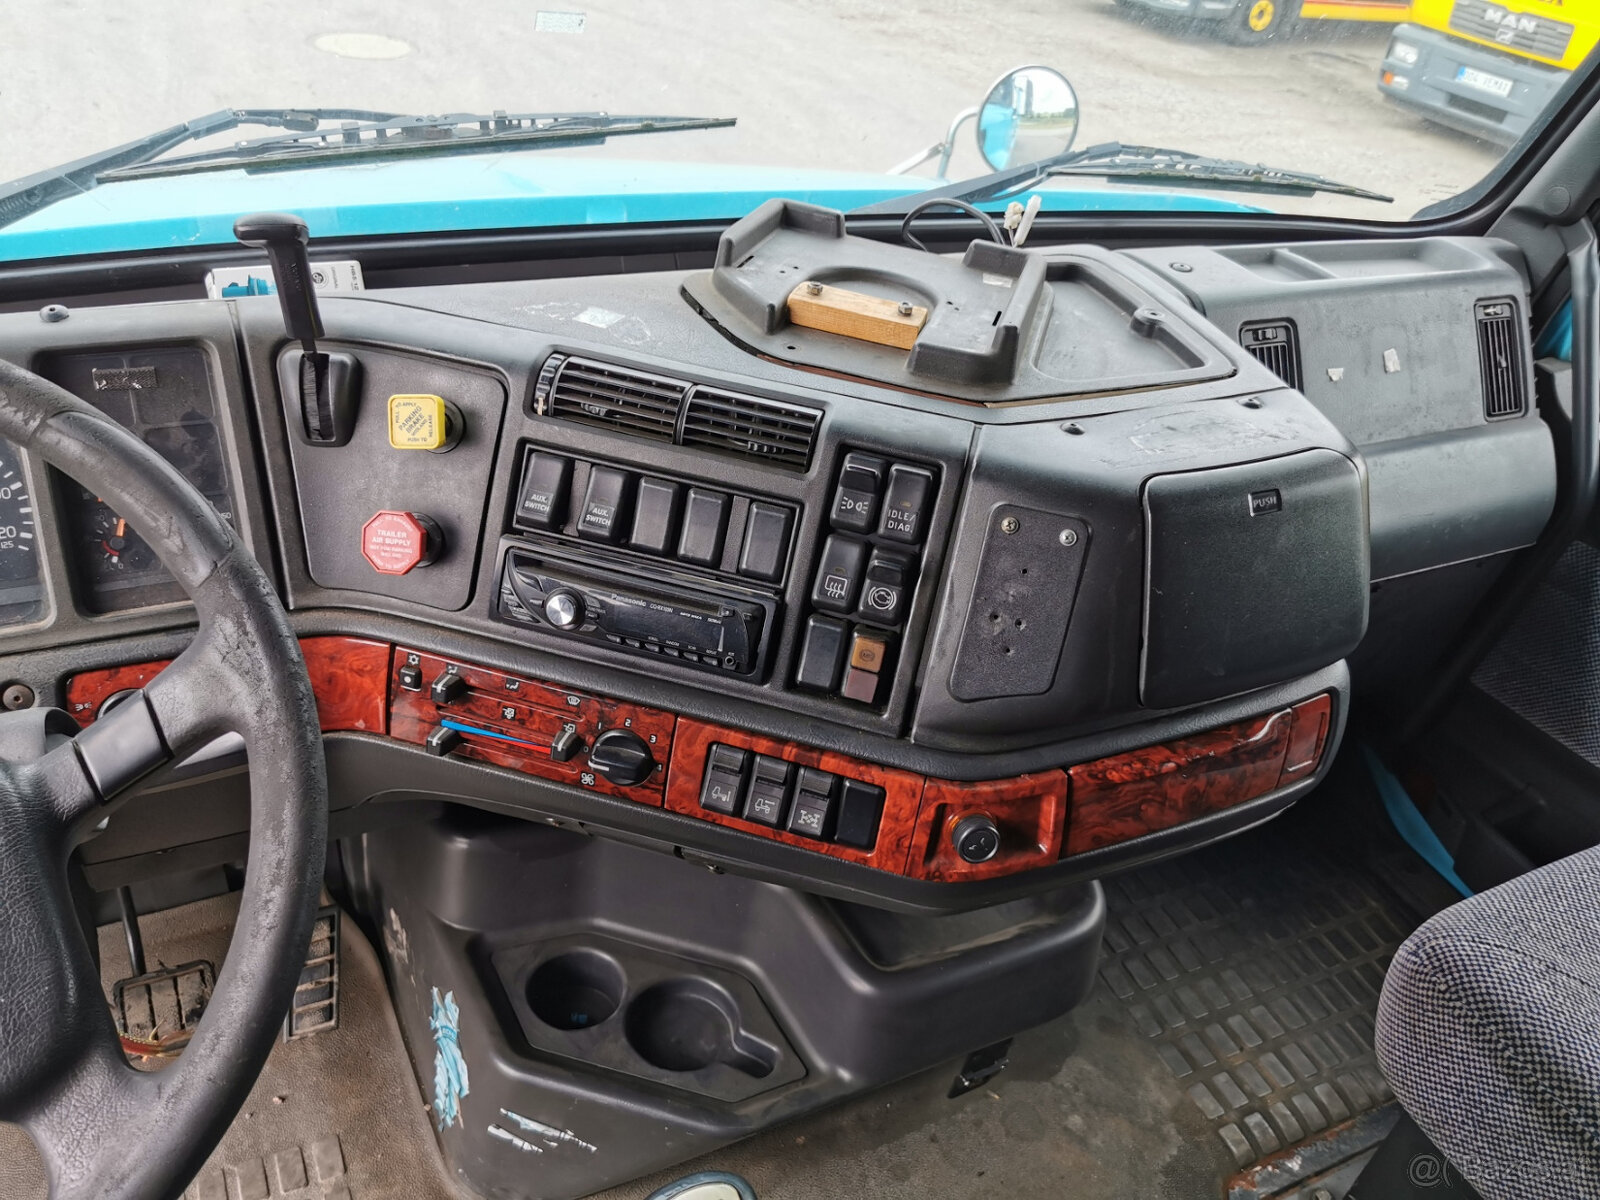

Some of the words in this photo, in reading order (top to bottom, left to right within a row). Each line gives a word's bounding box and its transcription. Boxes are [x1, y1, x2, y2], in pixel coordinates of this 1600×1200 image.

[1484, 8, 1537, 33] MAN
[398, 405, 422, 431] PARKING
[405, 413, 425, 434] BRAKE
[531, 493, 548, 503] AUX.
[1253, 496, 1277, 508] PUSH
[524, 500, 550, 512] SWITCH
[592, 507, 609, 517] AUX.
[585, 514, 611, 526] SWITCH
[887, 508, 917, 522] IDLE/
[887, 520, 913, 533] DIAG.
[377, 529, 407, 538] TRAILER
[0, 540, 15, 549] 125
[372, 536, 384, 544] AIR
[385, 537, 411, 547] SUPPLY
[611, 593, 647, 607] Panasonic
[624, 718, 631, 727] 2
[649, 734, 656, 743] 3
